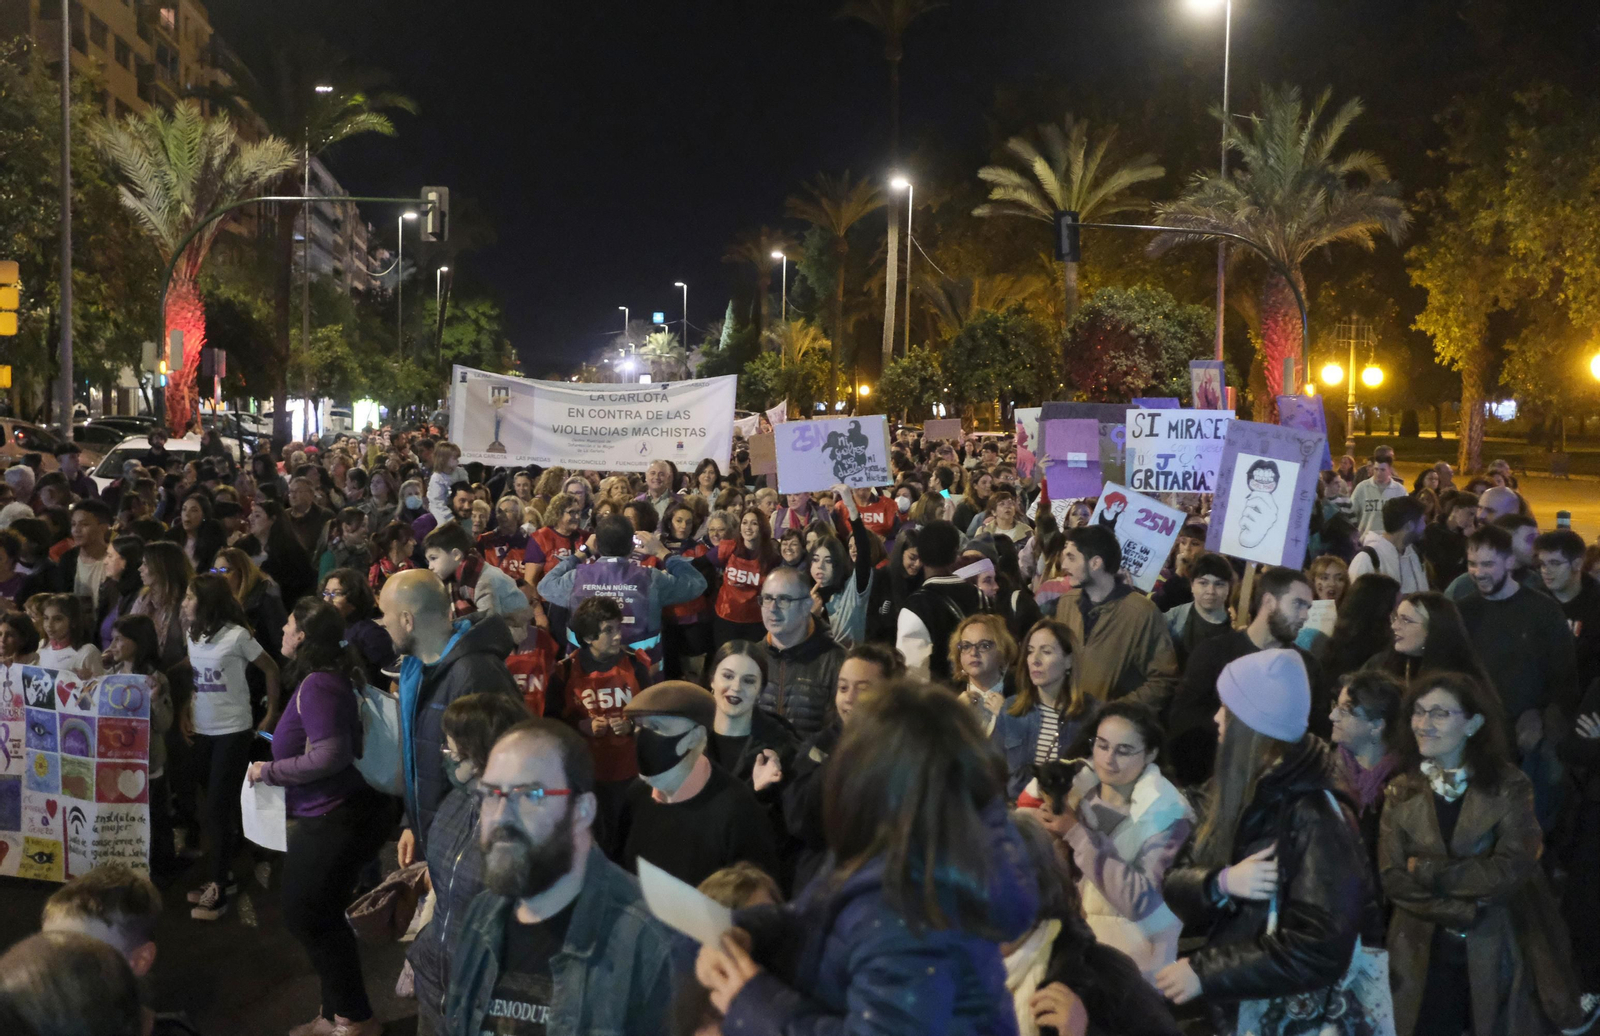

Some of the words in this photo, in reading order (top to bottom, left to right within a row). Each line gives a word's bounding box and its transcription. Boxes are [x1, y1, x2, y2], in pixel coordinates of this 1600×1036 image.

[589, 392, 605, 402] LA
[608, 393, 669, 403] CARLOTA
[568, 408, 584, 418] EN
[588, 409, 642, 420] CONTRA
[646, 411, 663, 420] DE
[667, 410, 691, 420] LAS
[551, 424, 628, 437] VIOLENCIAS
[631, 427, 707, 438] MACHISTAS
[1132, 412, 1161, 438] SI
[792, 424, 829, 451] 25N
[1134, 508, 1176, 536] 25N
[1127, 541, 1138, 550] ES
[583, 583, 611, 591] FERNÁN
[613, 583, 638, 592] NÚÑEZ
[513, 673, 544, 692] 5N
[100, 824, 132, 835] mujer
